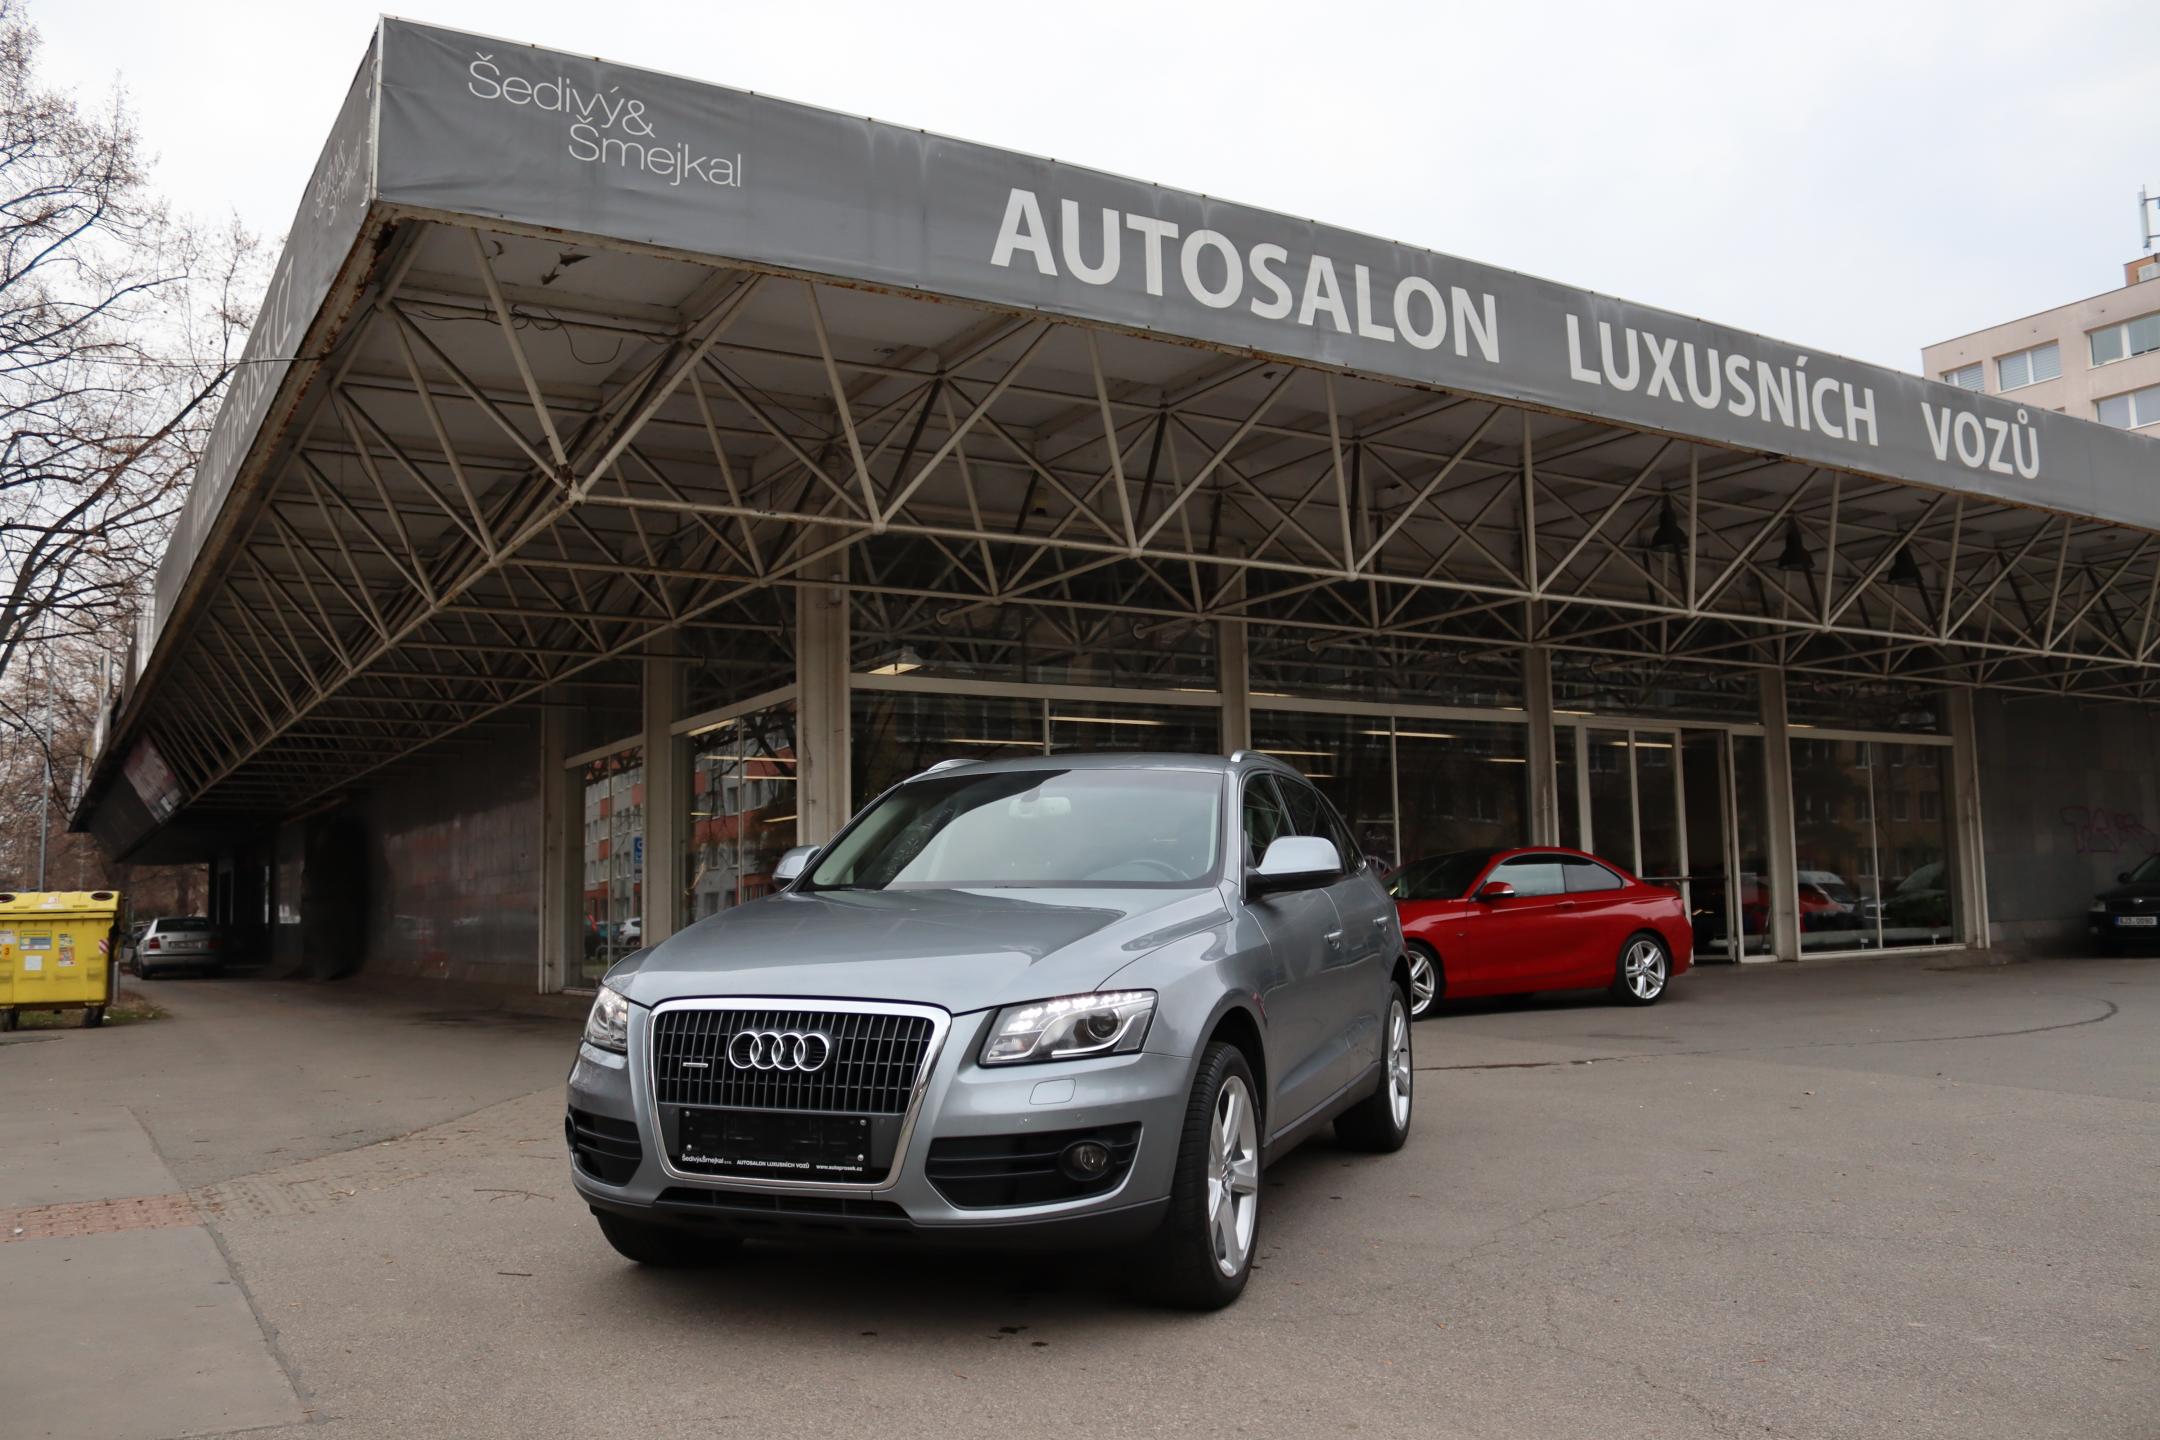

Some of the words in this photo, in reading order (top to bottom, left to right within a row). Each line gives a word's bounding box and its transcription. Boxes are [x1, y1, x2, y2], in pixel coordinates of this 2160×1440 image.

[468, 51, 656, 138] Šedivý&
[568, 114, 742, 187] Šmejkal
[990, 187, 1501, 364] AUTOSALON
[1565, 313, 1879, 447] LUXUSNÍCH
[1920, 401, 2041, 481] VOZŮ
[736, 1159, 767, 1167] AUTOSALON
